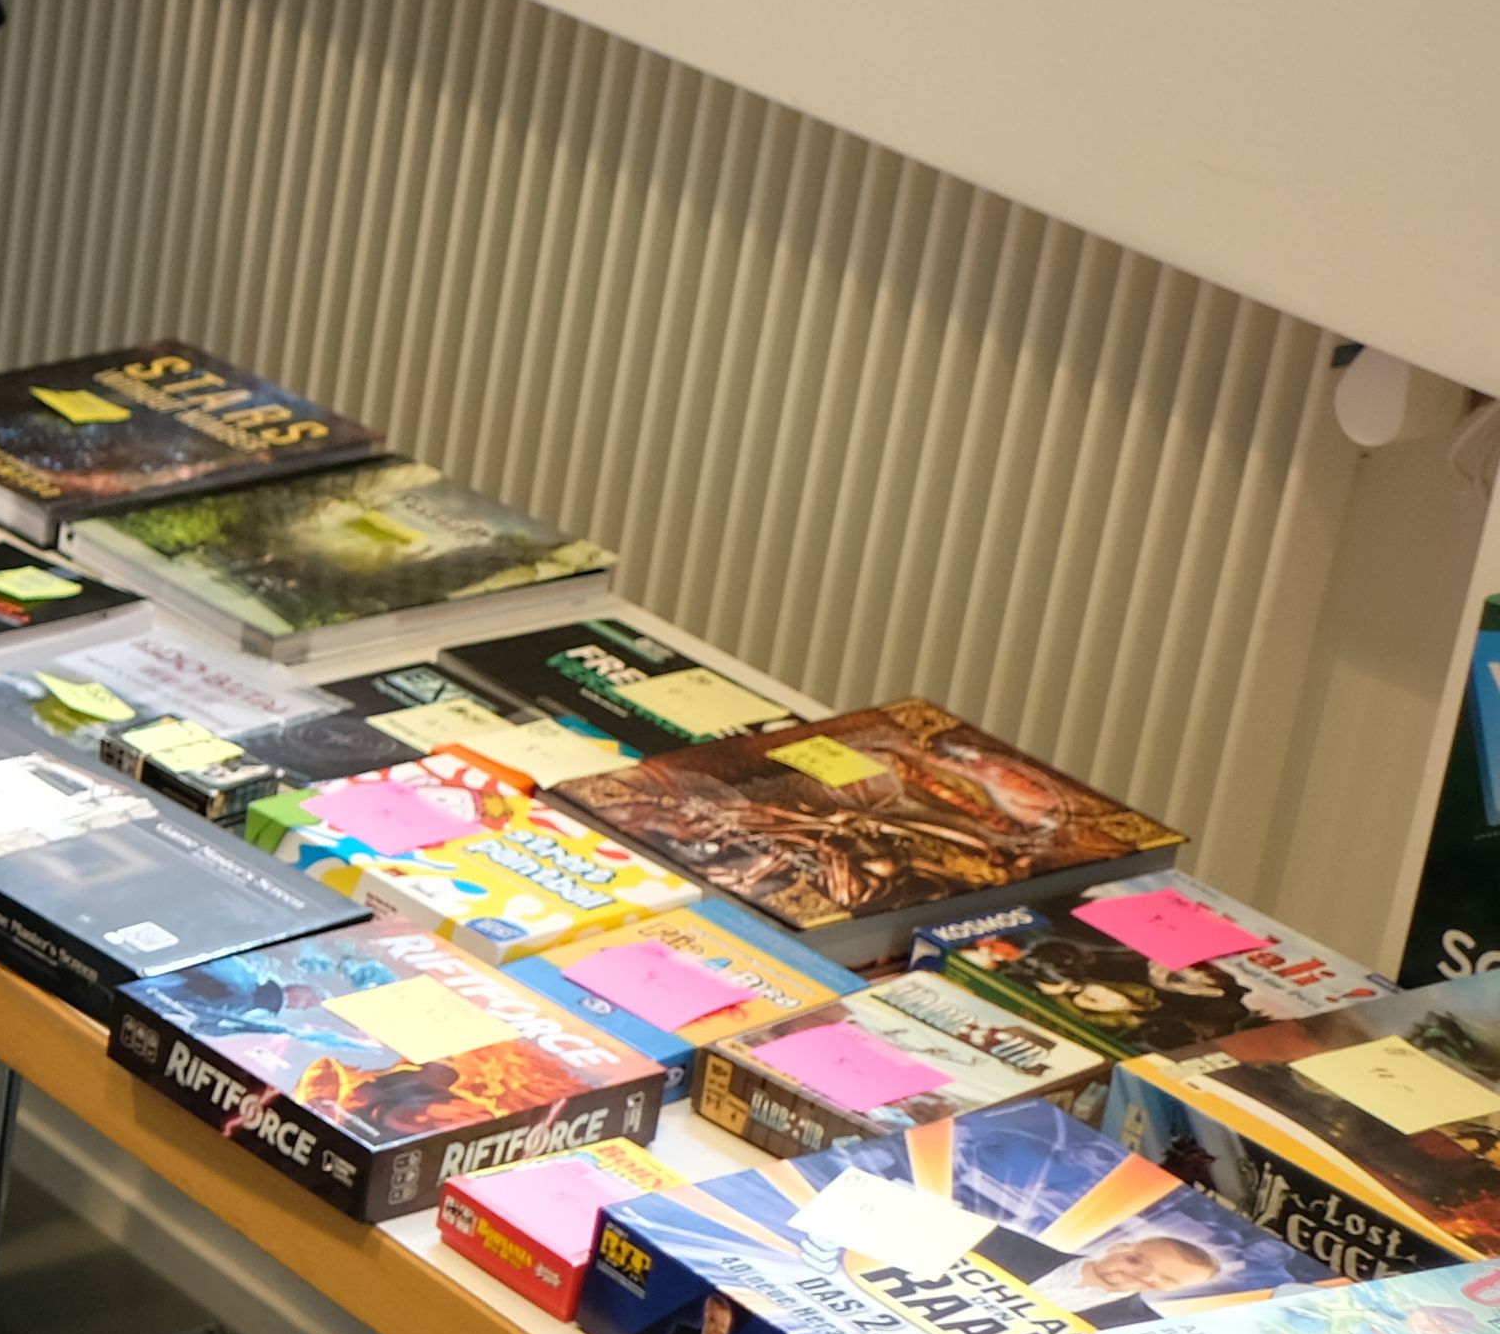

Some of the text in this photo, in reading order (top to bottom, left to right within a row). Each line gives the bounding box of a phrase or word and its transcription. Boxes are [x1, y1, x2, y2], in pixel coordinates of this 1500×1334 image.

[124, 354, 329, 447] STARS
[931, 908, 1035, 943] KOSMOS
[373, 929, 622, 1069] RIFTFORCE
[164, 1038, 318, 1167] RIFTFORCE
[437, 1107, 609, 1187] RIFTFORCE
[1319, 1194, 1405, 1253] Lost
[719, 1254, 747, 1281] 40
[797, 1277, 855, 1317] DAS
